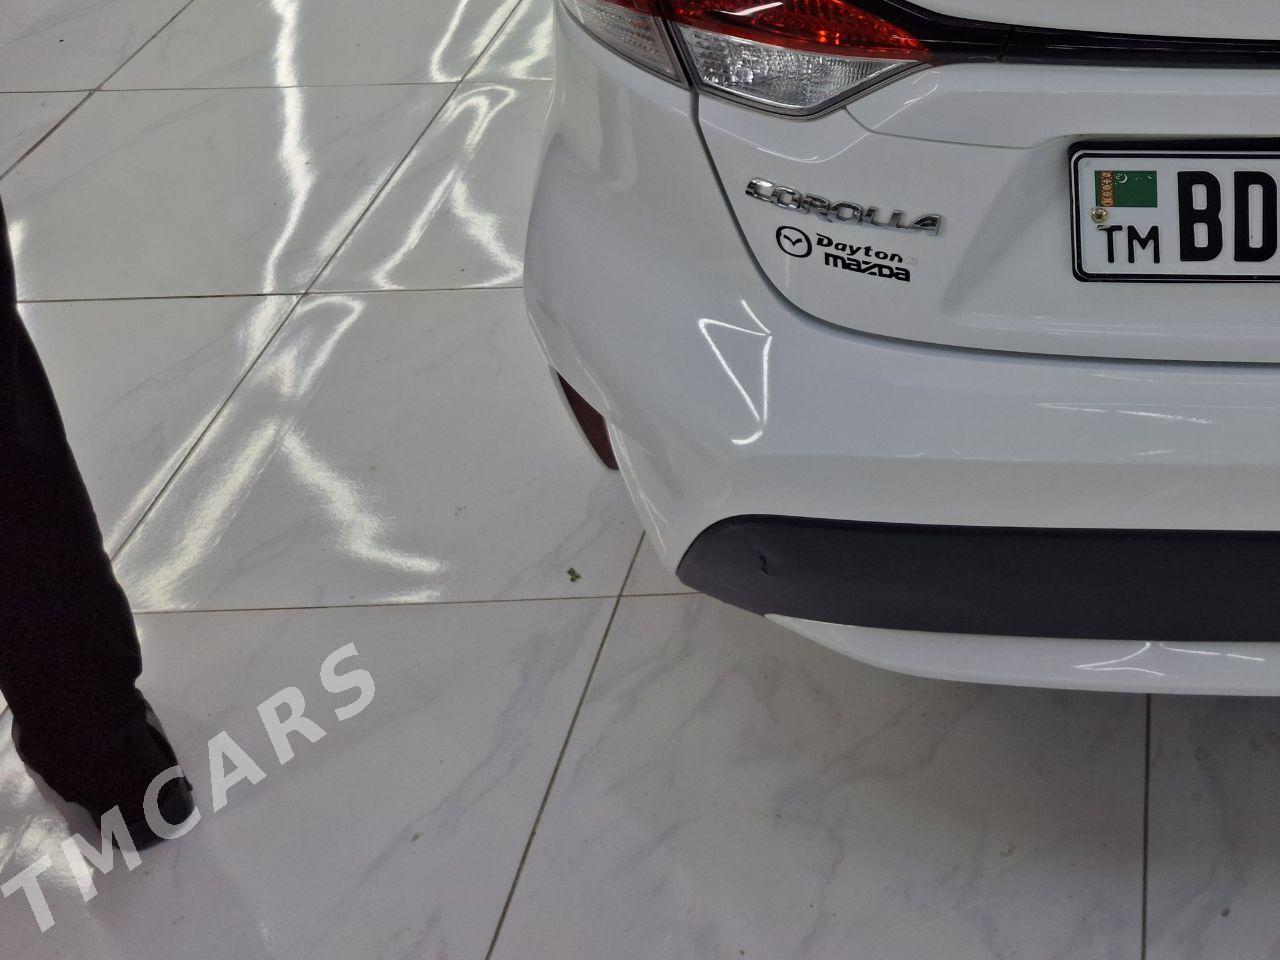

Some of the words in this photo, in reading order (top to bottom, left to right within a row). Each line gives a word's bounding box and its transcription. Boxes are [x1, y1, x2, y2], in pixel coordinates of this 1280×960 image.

[745, 177, 943, 236] COROLLA
[1177, 170, 1278, 262] BD
[816, 232, 903, 263] Dayton
[1097, 224, 1161, 264] TM
